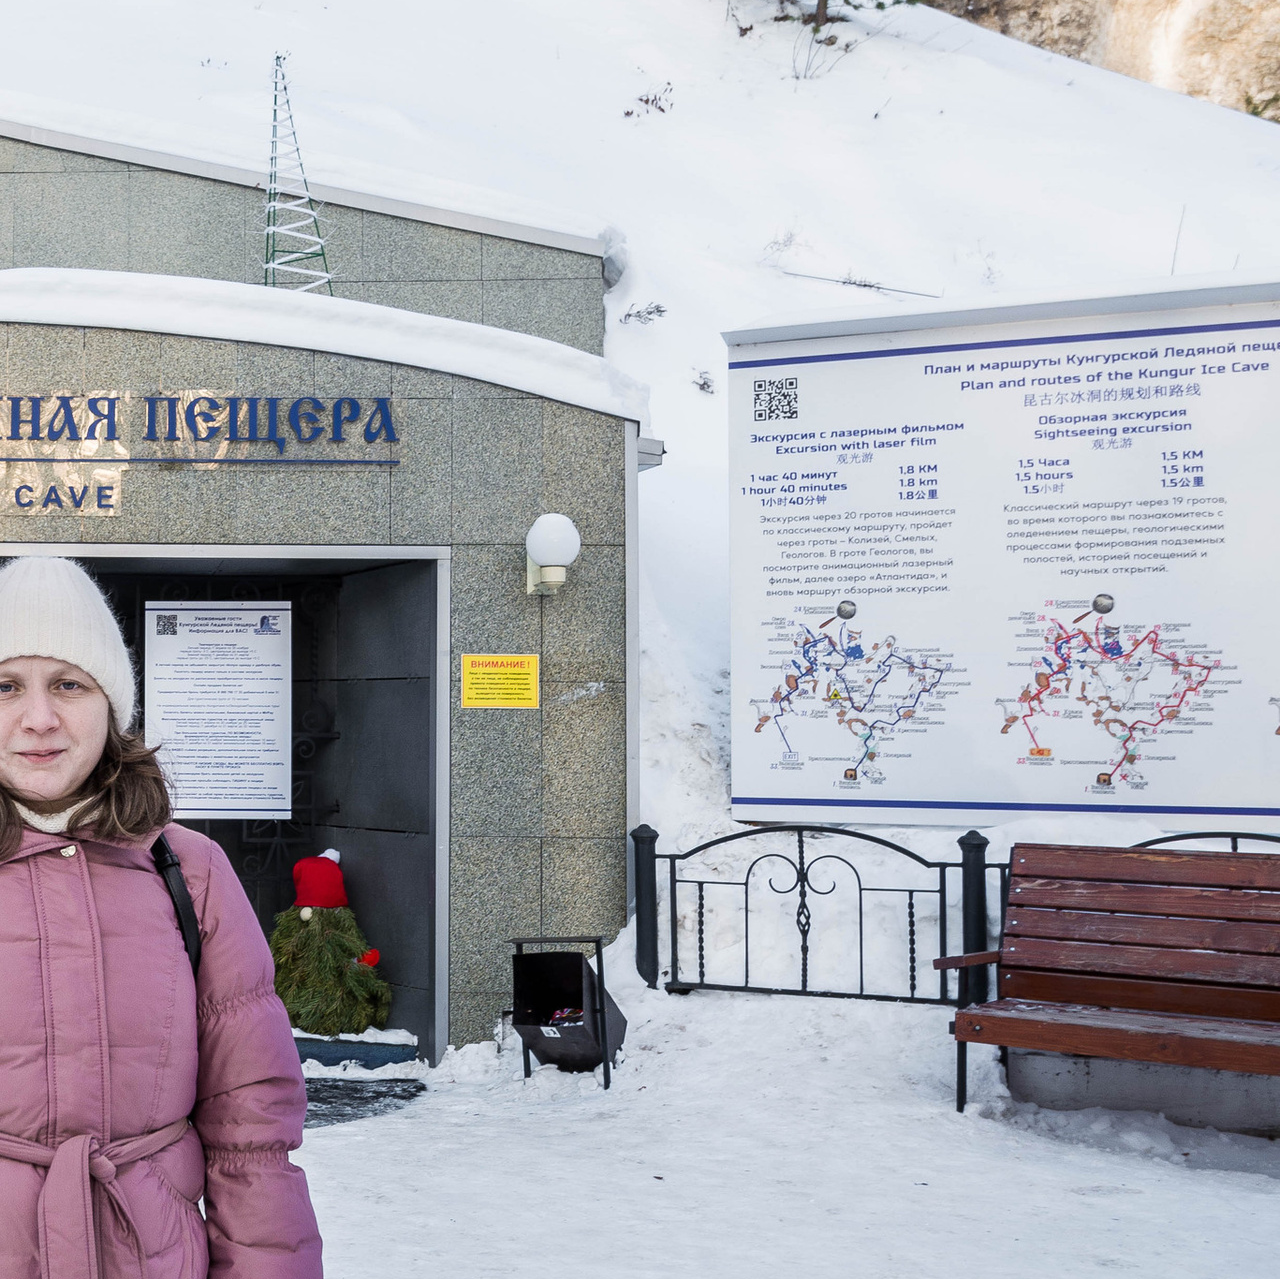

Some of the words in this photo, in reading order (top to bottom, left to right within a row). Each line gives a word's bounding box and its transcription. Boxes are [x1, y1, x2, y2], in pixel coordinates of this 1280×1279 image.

[924, 364, 960, 374] План
[980, 358, 1060, 370] маршруты
[1066, 348, 1158, 365] Кунгурской
[1164, 342, 1235, 357] Ледяной
[961, 380, 993, 390] Plan
[998, 377, 1025, 388] and
[1031, 375, 1081, 385] routes
[1086, 371, 1102, 382] of
[1107, 370, 1132, 380] the
[1138, 367, 1195, 378] Kungur
[1201, 364, 1225, 374] Ice
[1231, 362, 1269, 372] Cave
[1038, 414, 1106, 424] Обзорная
[1112, 409, 1186, 420] экскурсия
[144, 396, 400, 454] ПЕЩЕРА
[1034, 427, 1116, 439] Sightseeing
[1122, 422, 1191, 433] excursion
[750, 432, 815, 442] Экскурсия
[830, 427, 896, 437] лазерным
[901, 423, 964, 434] фильмом
[776, 444, 836, 454] Excursion
[840, 440, 868, 450] with
[873, 440, 905, 448] laser
[910, 437, 936, 445] film
[1092, 437, 1132, 449] 观光游
[836, 452, 873, 464] 观光游
[1183, 464, 1203, 472] km
[782, 471, 797, 480] 40
[801, 471, 837, 480] минут
[780, 484, 794, 492] 40
[799, 483, 847, 491] minutes
[15, 485, 114, 509] CAVE
[1003, 502, 1078, 511] Классический
[1082, 501, 1132, 509] маршрут
[1135, 499, 1168, 507] через
[1172, 496, 1183, 504] 19
[760, 515, 810, 524] Экскурсия
[844, 511, 856, 519] 20
[859, 511, 892, 520] гротов
[1022, 517, 1054, 526] время
[1058, 515, 1107, 523] которого
[1128, 511, 1214, 519] познакомитесь
[910, 520, 952, 530] пройдет
[1132, 524, 1224, 532] геологическими
[808, 539, 837, 547] гроты
[1006, 543, 1071, 552] процессами
[1074, 540, 1157, 549] формирования
[829, 549, 836, 557] В
[839, 550, 866, 558] гроте
[1078, 552, 1130, 562] историей
[1133, 550, 1196, 559] посещений
[821, 560, 898, 569] анимационный
[901, 558, 953, 567] лазерный
[1060, 568, 1108, 576] научных
[796, 588, 841, 596] маршрут
[843, 585, 892, 594] обзорной
